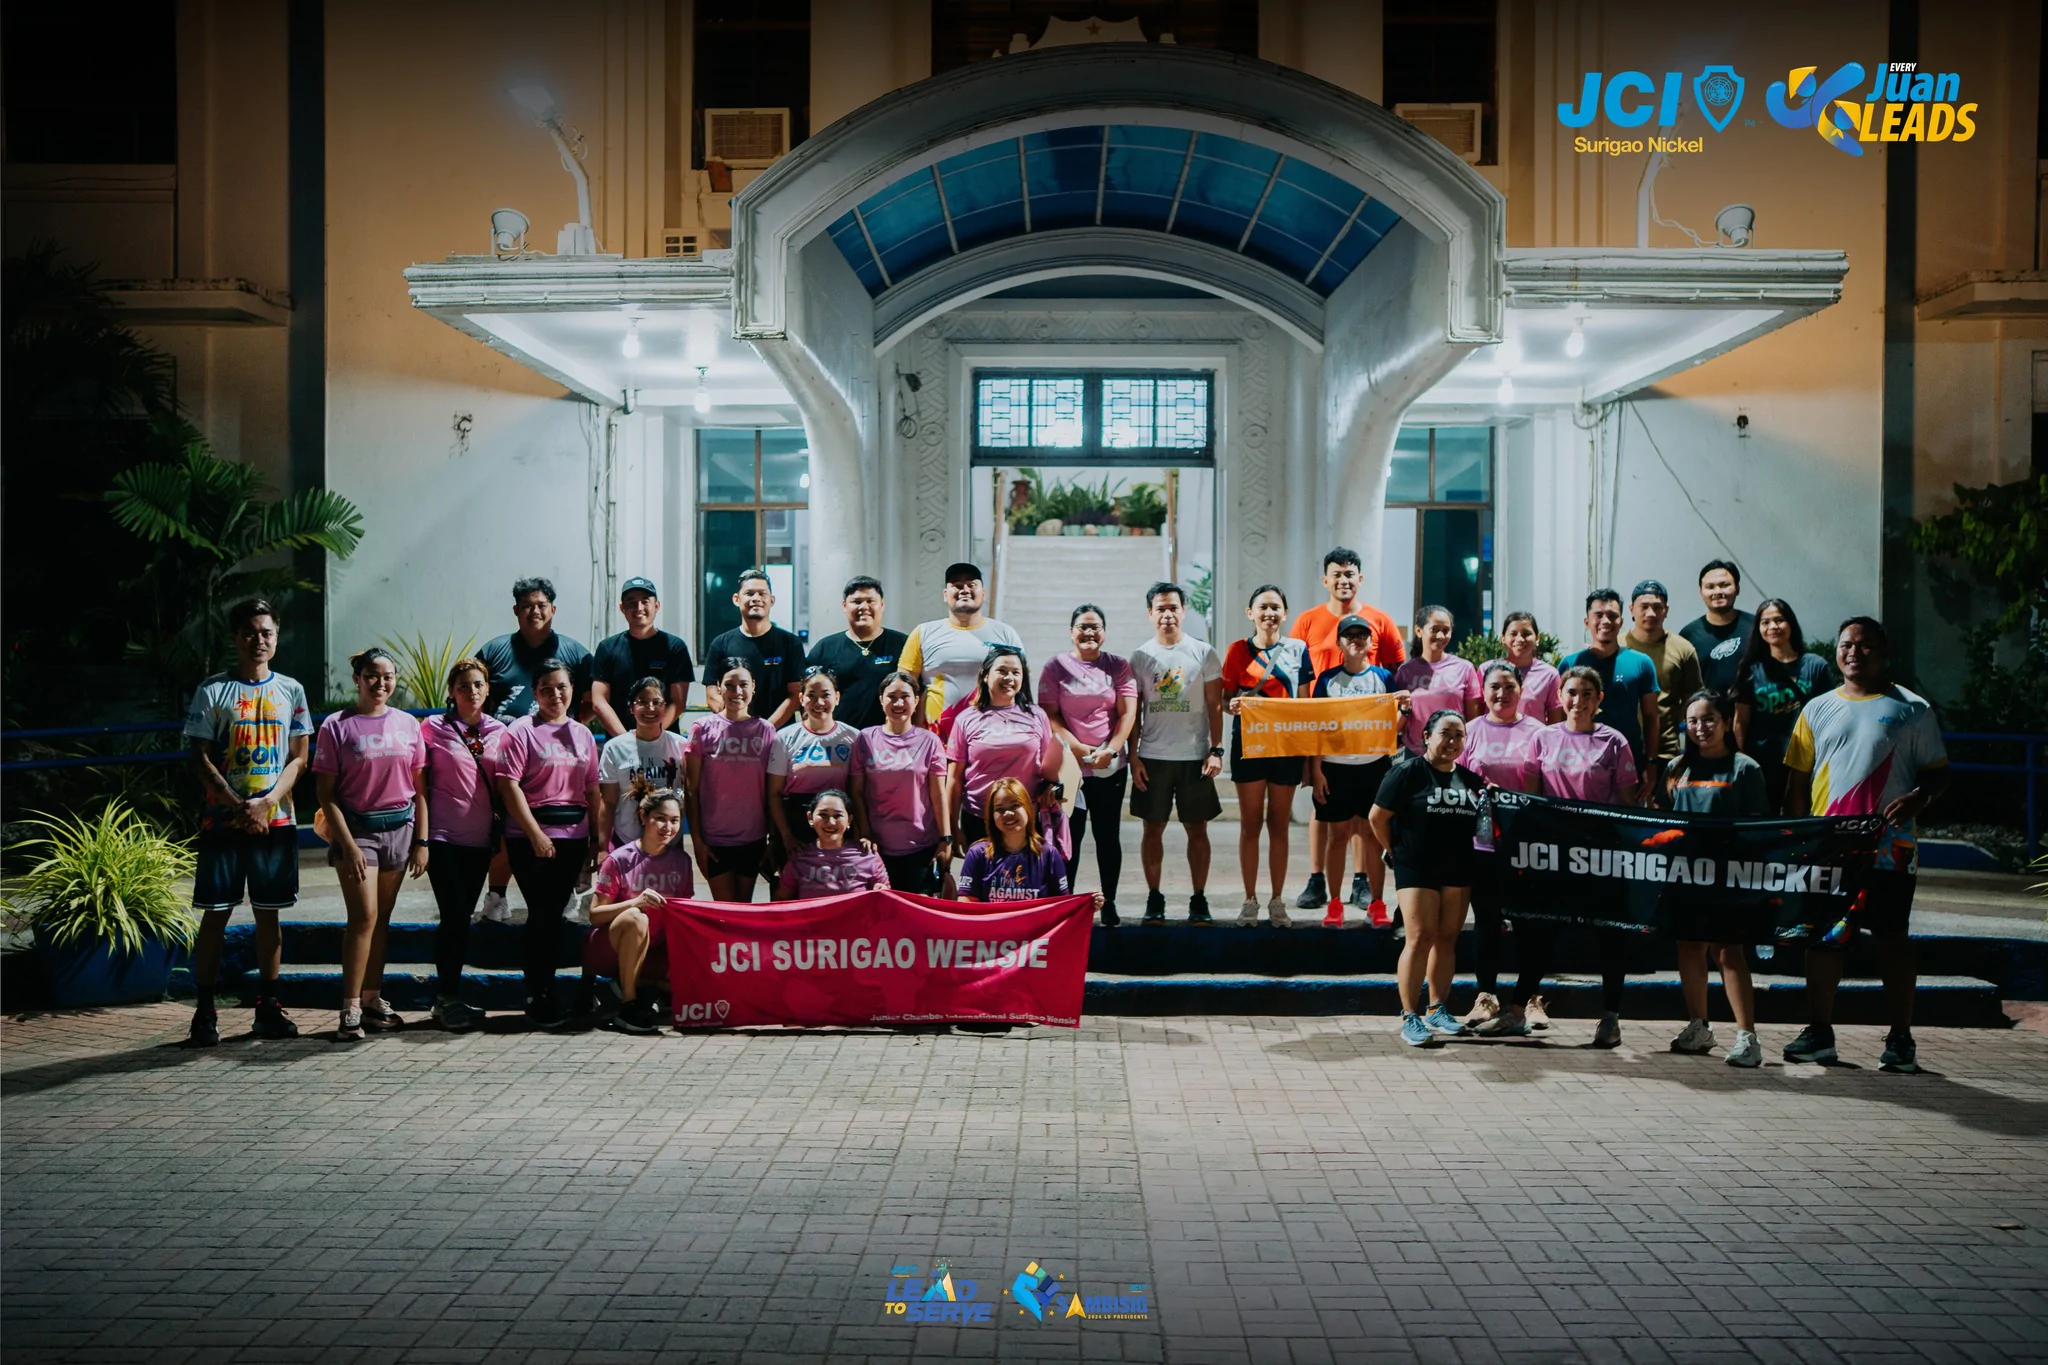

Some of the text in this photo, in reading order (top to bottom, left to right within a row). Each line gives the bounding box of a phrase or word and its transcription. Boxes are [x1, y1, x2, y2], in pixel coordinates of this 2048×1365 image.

[1246, 719, 1393, 735] JCI SURIGAO NORTH
[353, 733, 394, 752] JCI
[793, 745, 831, 762] JCI
[252, 767, 269, 775] 2022
[1427, 786, 1467, 806] JCI
[1491, 791, 1517, 805] JCI
[1427, 805, 1454, 815] Surigao
[1834, 819, 1868, 831] JCI
[1511, 841, 1848, 896] JCI SURIGAO NICKEL
[632, 873, 665, 892] JCI
[989, 887, 1040, 900] AGAINST
[711, 938, 1050, 974] JCI SURIGAO WENSIE
[675, 1002, 712, 1022] JCI
